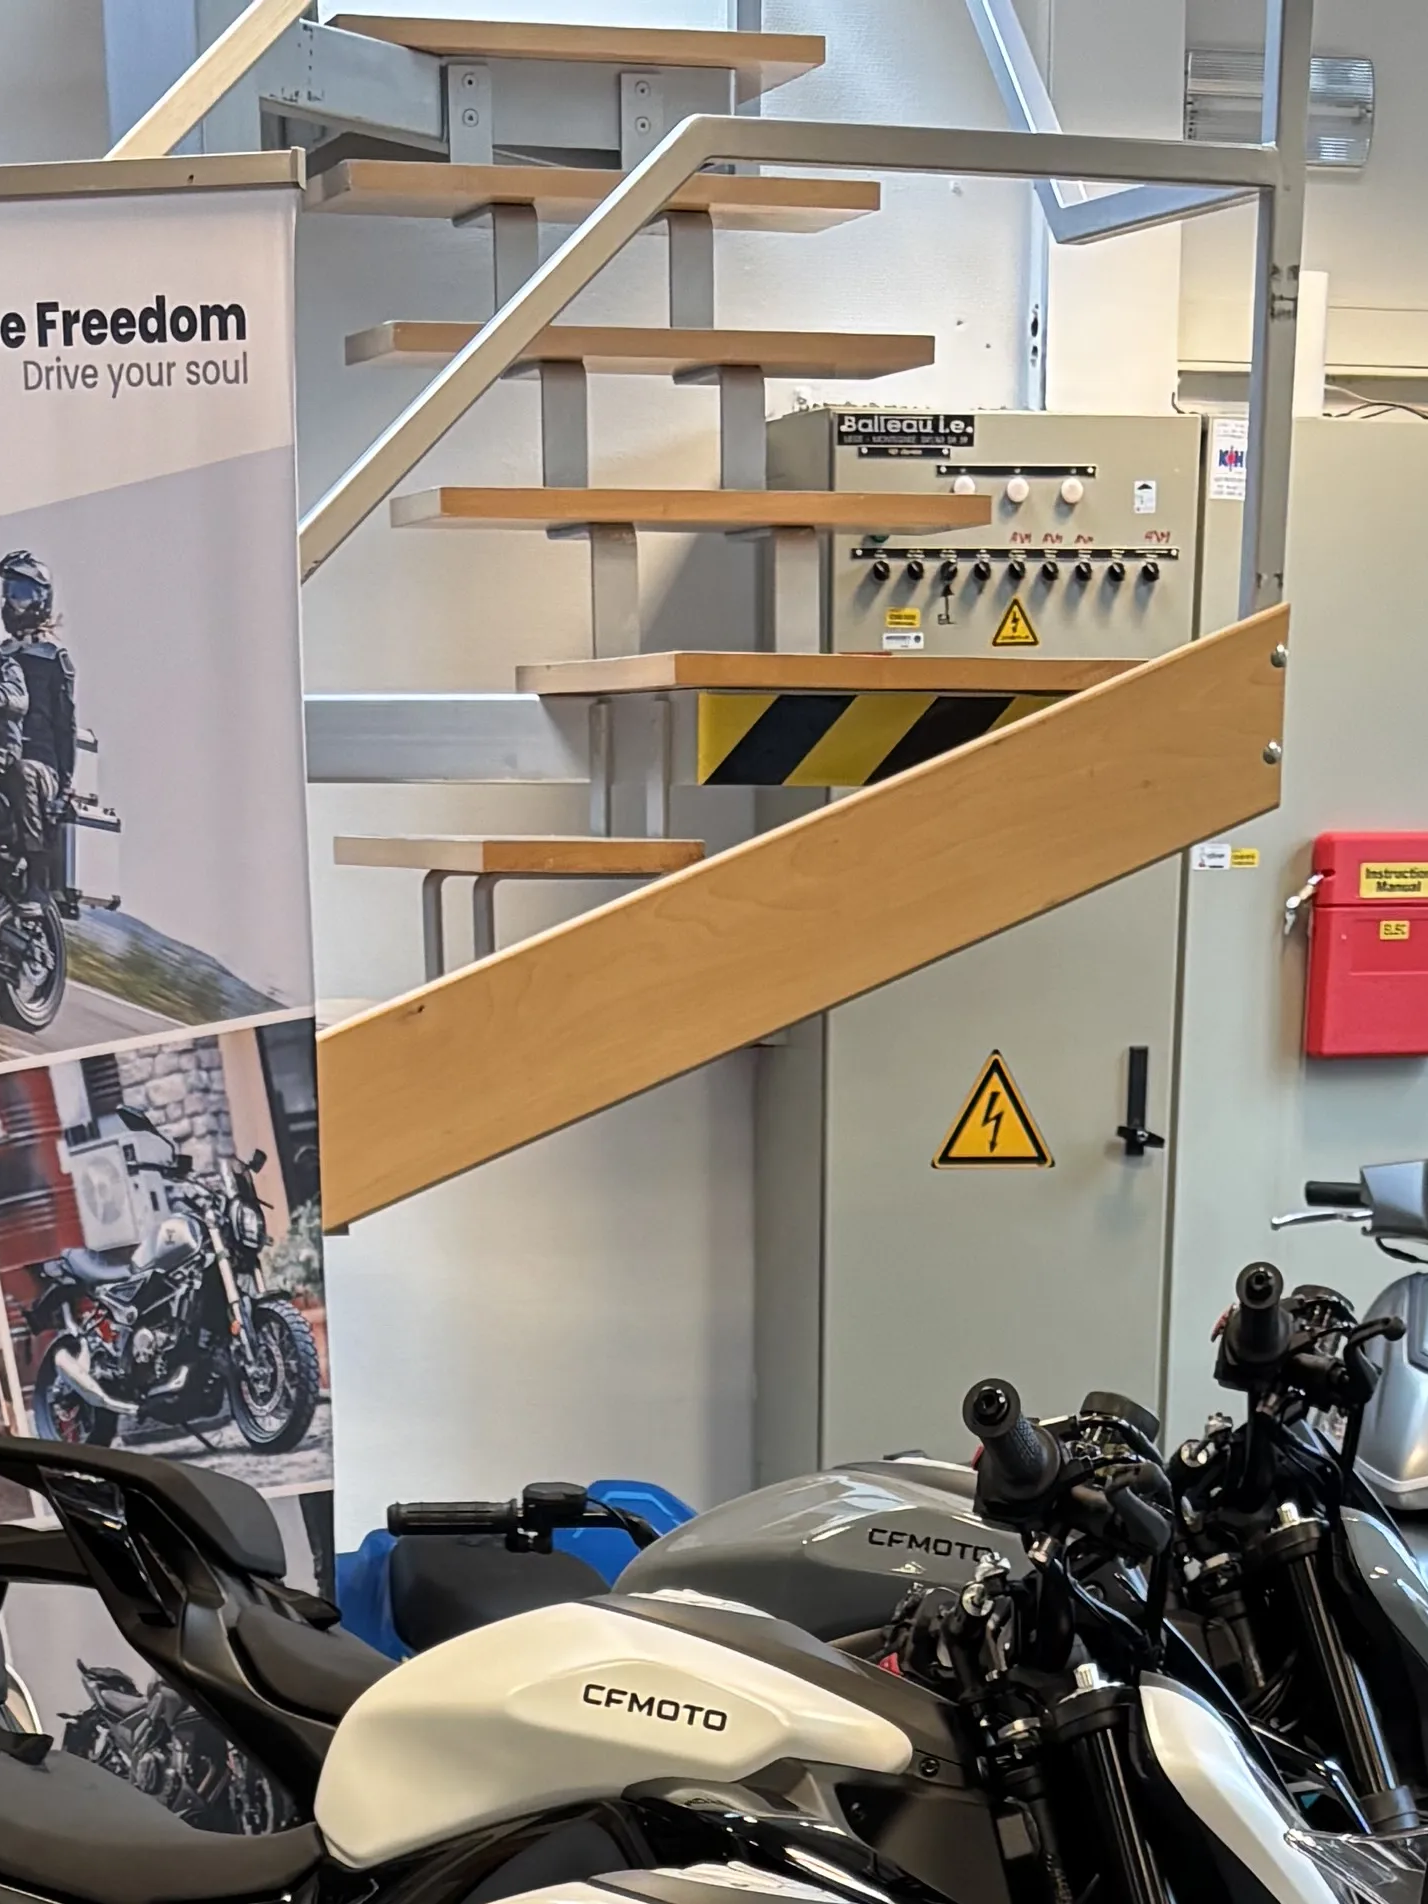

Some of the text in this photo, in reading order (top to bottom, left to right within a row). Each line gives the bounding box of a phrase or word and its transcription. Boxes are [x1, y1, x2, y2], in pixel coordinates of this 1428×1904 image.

[37, 295, 246, 347] Freedom
[23, 352, 249, 398] Drive your soul
[1376, 881, 1422, 893] Manual
[868, 1527, 994, 1562] CFMOTO
[583, 1684, 728, 1732] CFMOTO
